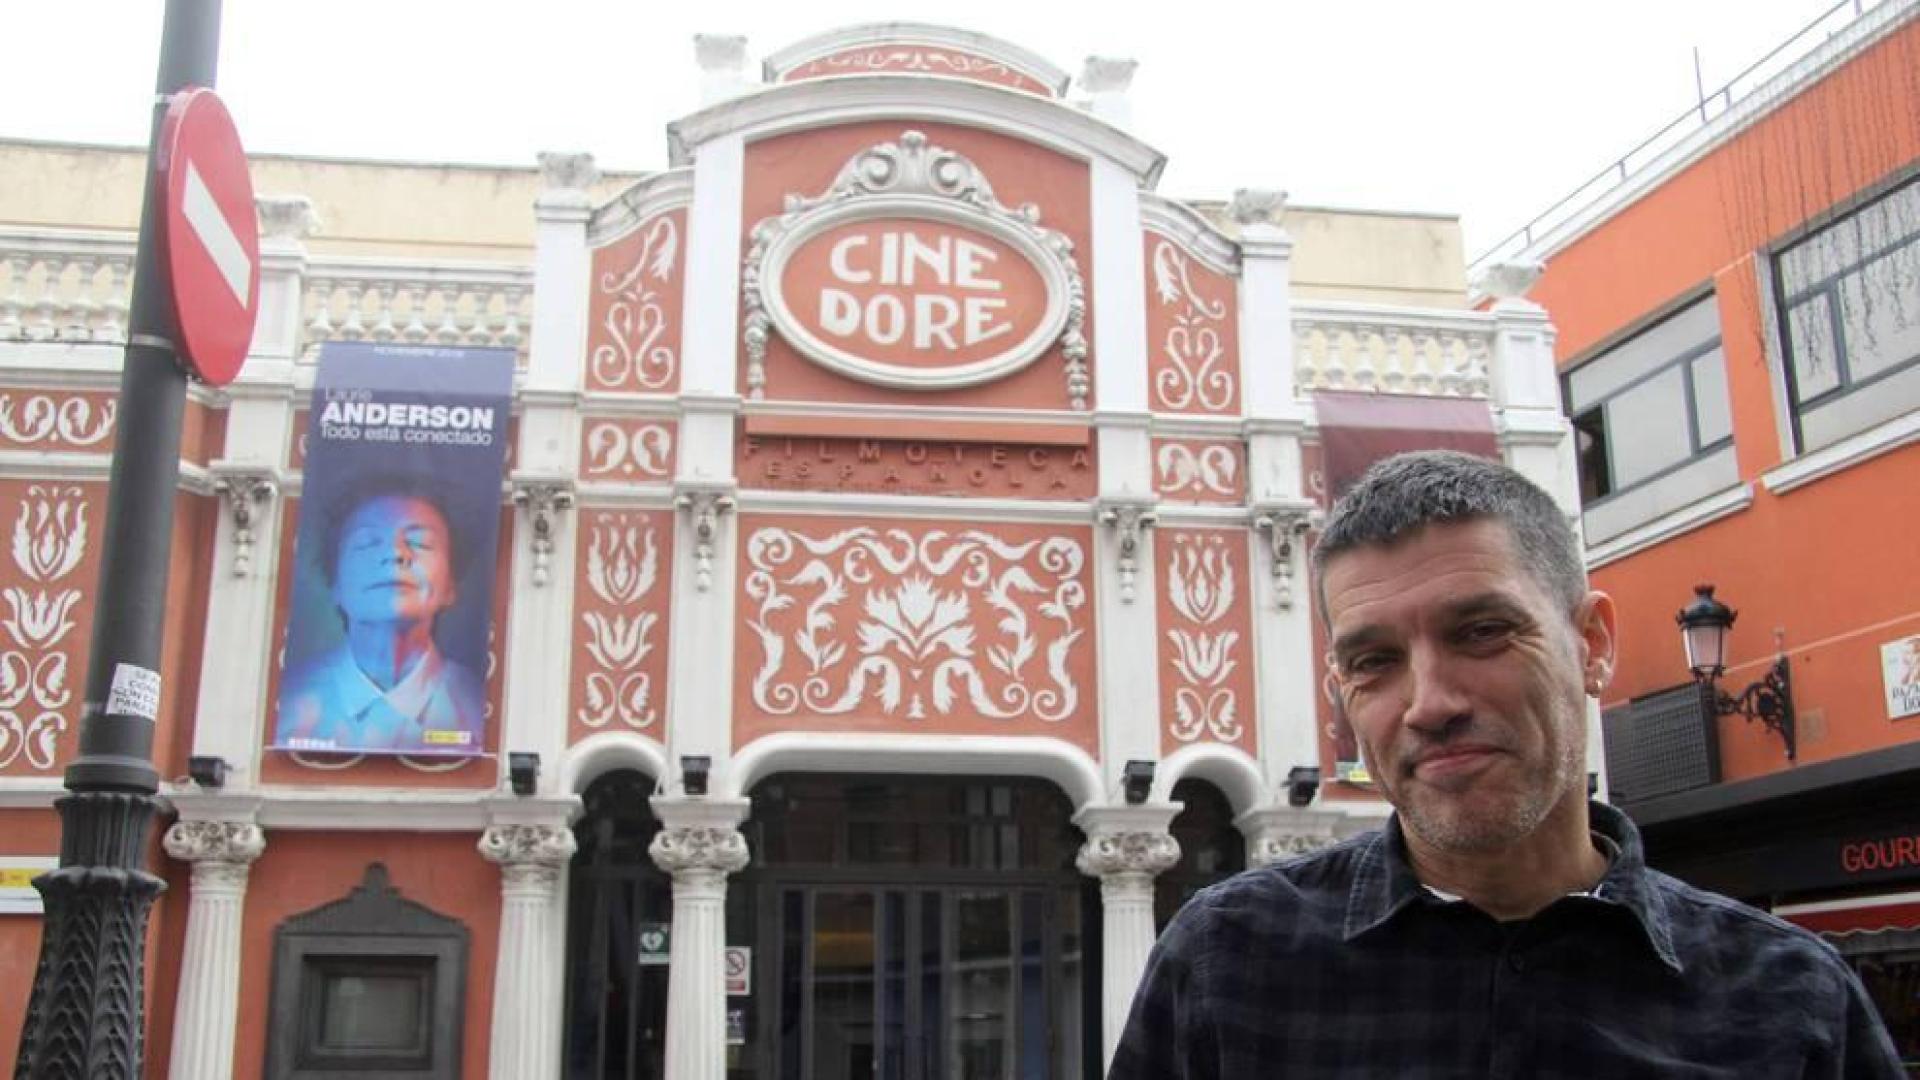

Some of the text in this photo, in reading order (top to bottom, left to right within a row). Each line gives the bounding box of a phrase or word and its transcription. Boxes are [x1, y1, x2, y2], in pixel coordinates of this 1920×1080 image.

[830, 232, 1002, 291] CINE
[819, 288, 1013, 350] DORE
[321, 401, 494, 430] ANDERSON
[322, 422, 492, 445] Todo está conectado
[743, 438, 1089, 470] FILMOTECA
[1841, 834, 1920, 873] GOUR
